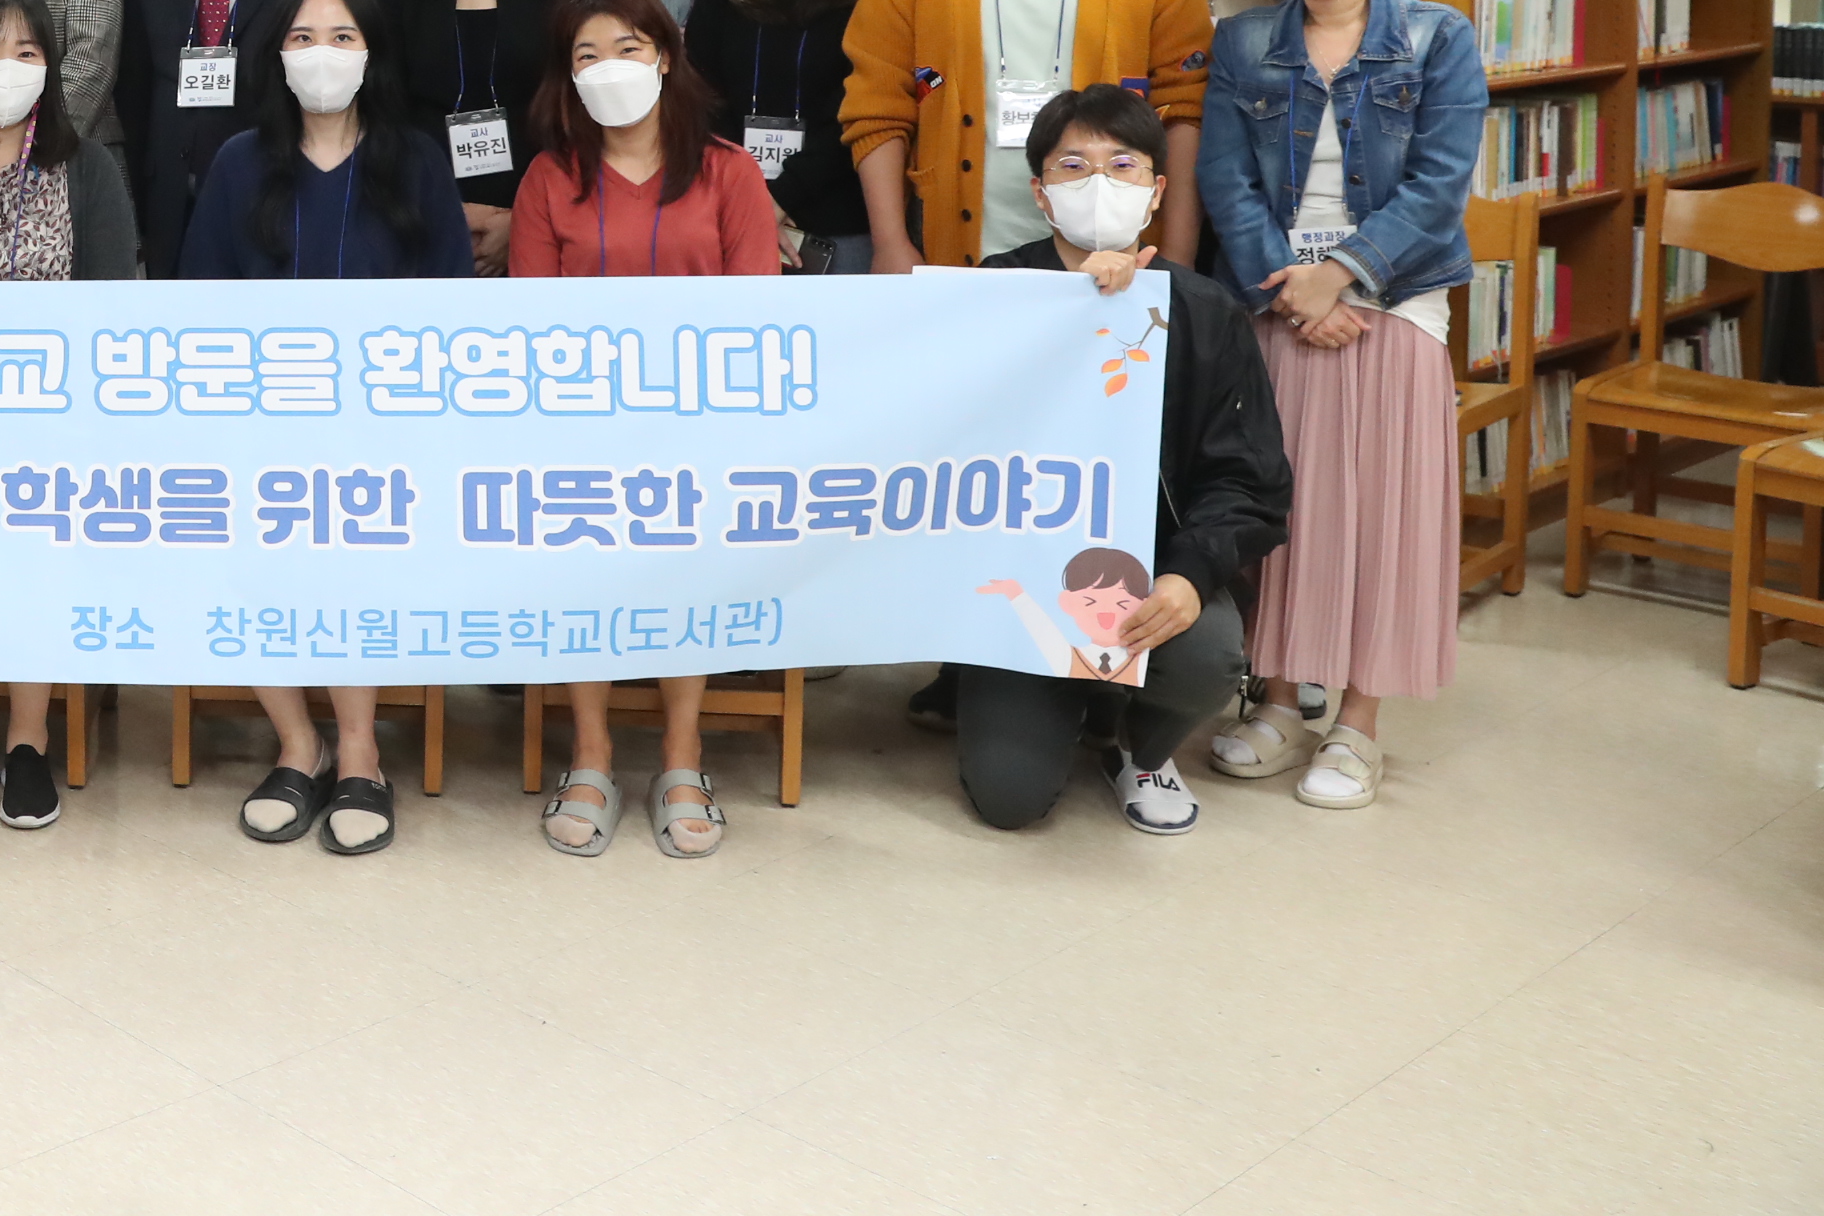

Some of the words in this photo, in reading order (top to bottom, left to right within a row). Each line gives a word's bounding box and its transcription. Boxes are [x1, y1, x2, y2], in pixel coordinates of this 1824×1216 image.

[200, 62, 216, 71] 교장
[184, 74, 231, 90] 오길환
[470, 127, 488, 138] 교사
[765, 134, 783, 143] 교사
[456, 137, 507, 159] 박유진
[1302, 231, 1345, 243] 행정과장
[92, 328, 342, 416] 방문을
[360, 325, 818, 416] 환영합니다!
[252, 465, 419, 550] 위한
[458, 465, 706, 551] 따뜻한
[721, 450, 1115, 549] 교육이야기
[71, 605, 156, 653] 장소
[205, 598, 783, 660] 창원신월고등학교(도서관)
[1136, 773, 1181, 791] FILA
